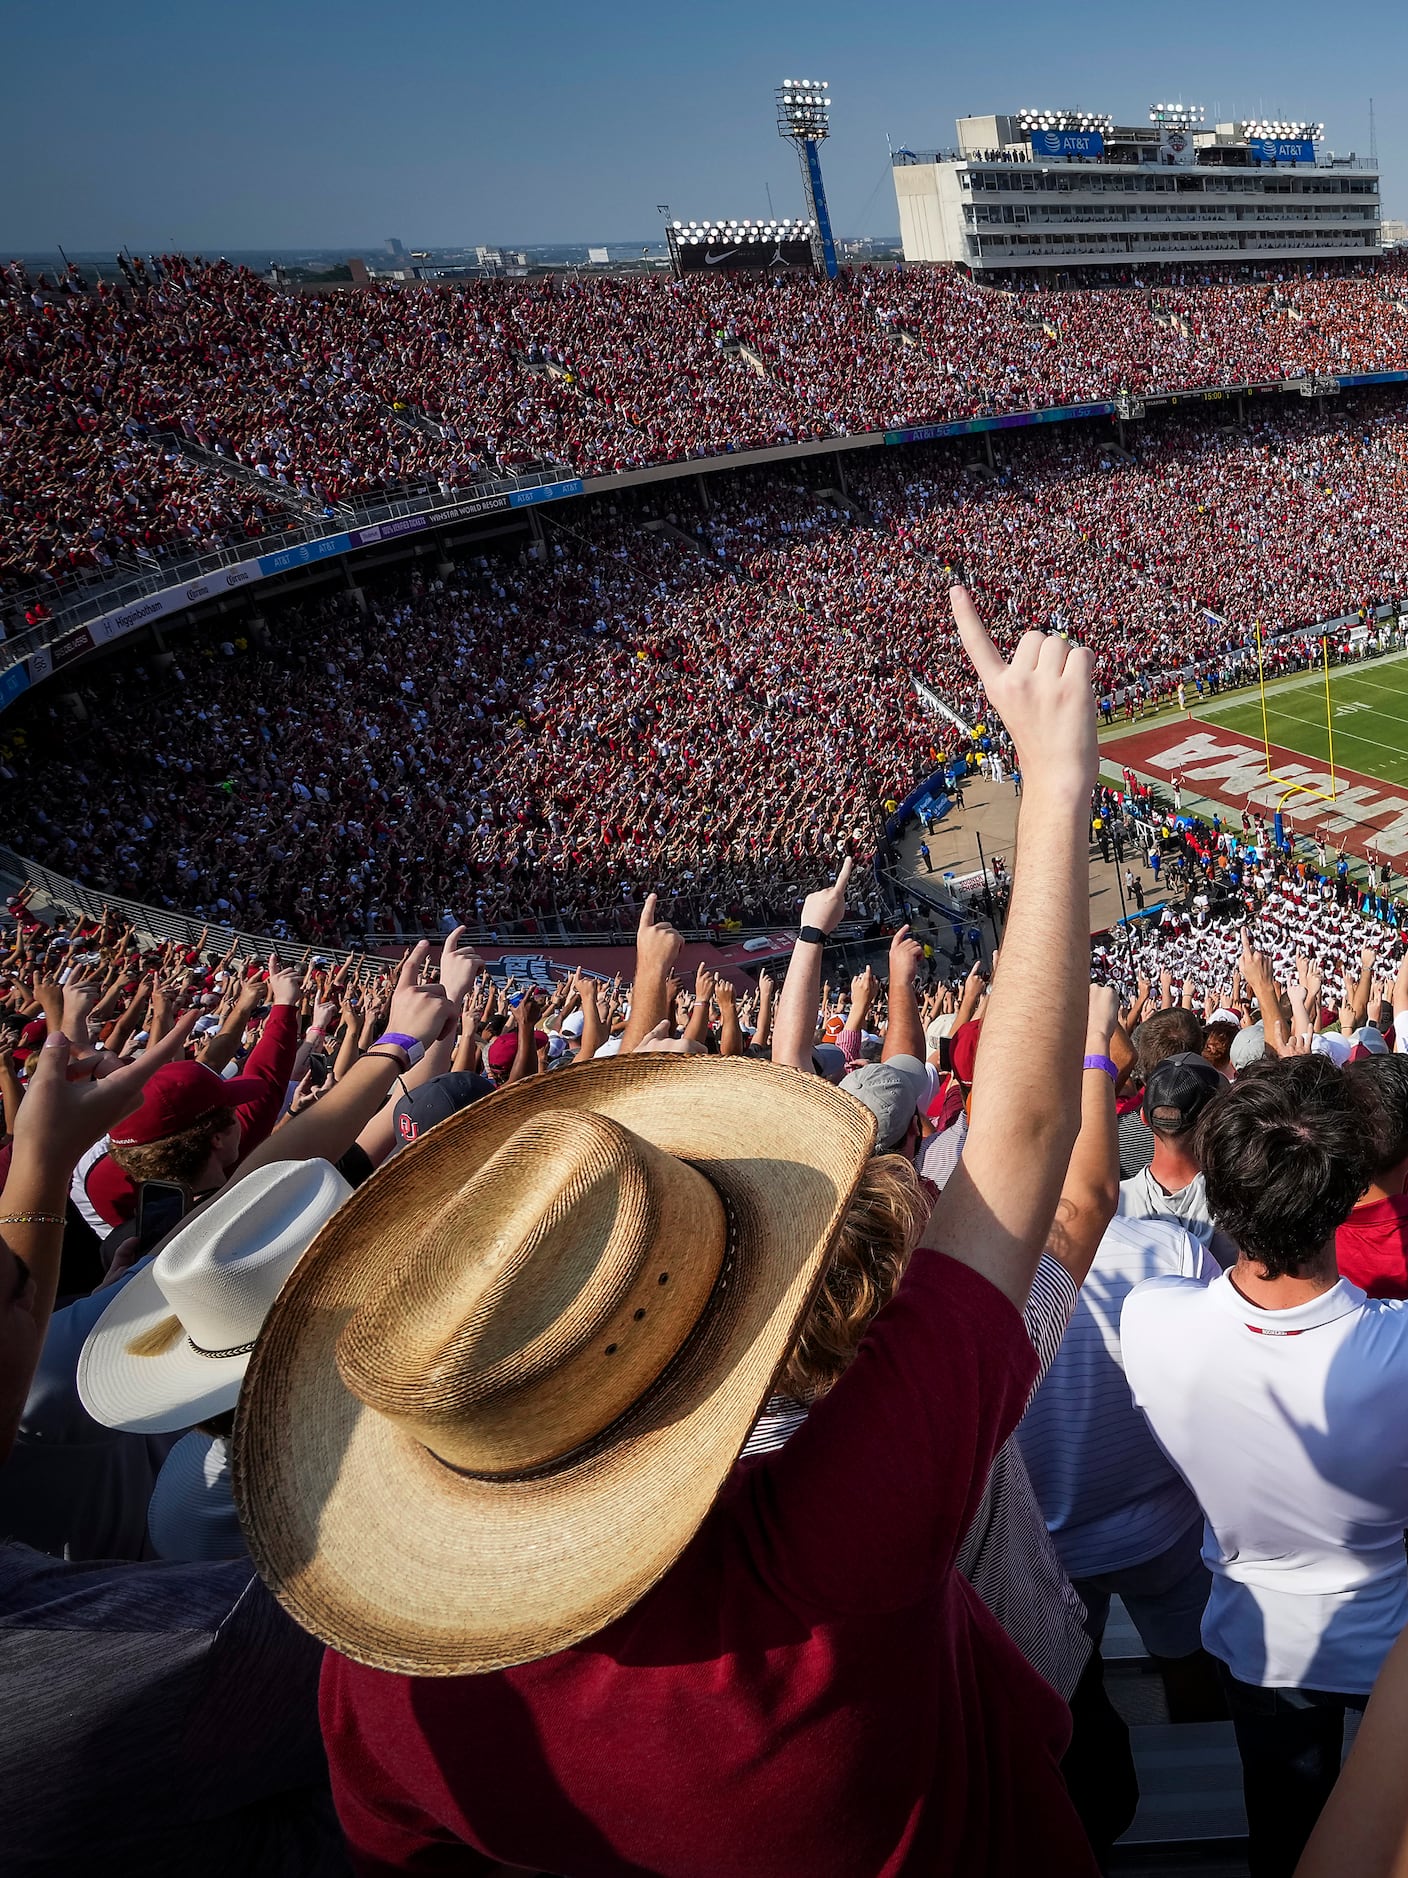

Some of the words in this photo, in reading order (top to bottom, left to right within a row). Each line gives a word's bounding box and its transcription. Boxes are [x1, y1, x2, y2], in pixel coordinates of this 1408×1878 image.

[1063, 136, 1091, 151] AT&T
[1279, 143, 1304, 156] AT&T
[1204, 391, 1222, 401] 15:00
[913, 428, 936, 441] AT&T
[936, 425, 951, 437] 5G
[517, 492, 534, 504] AT&T
[562, 482, 578, 494] AT&T
[429, 508, 460, 523] WINSTAR
[459, 503, 482, 516] WORLD
[482, 498, 508, 511] RESORT
[409, 516, 427, 529] TICKETS
[274, 554, 291, 568] AT&T
[319, 540, 336, 554] AT&T
[187, 586, 209, 601] Corona
[226, 572, 249, 586] Corona
[115, 601, 163, 629] Higginbotham
[399, 1113, 419, 1142] OU
